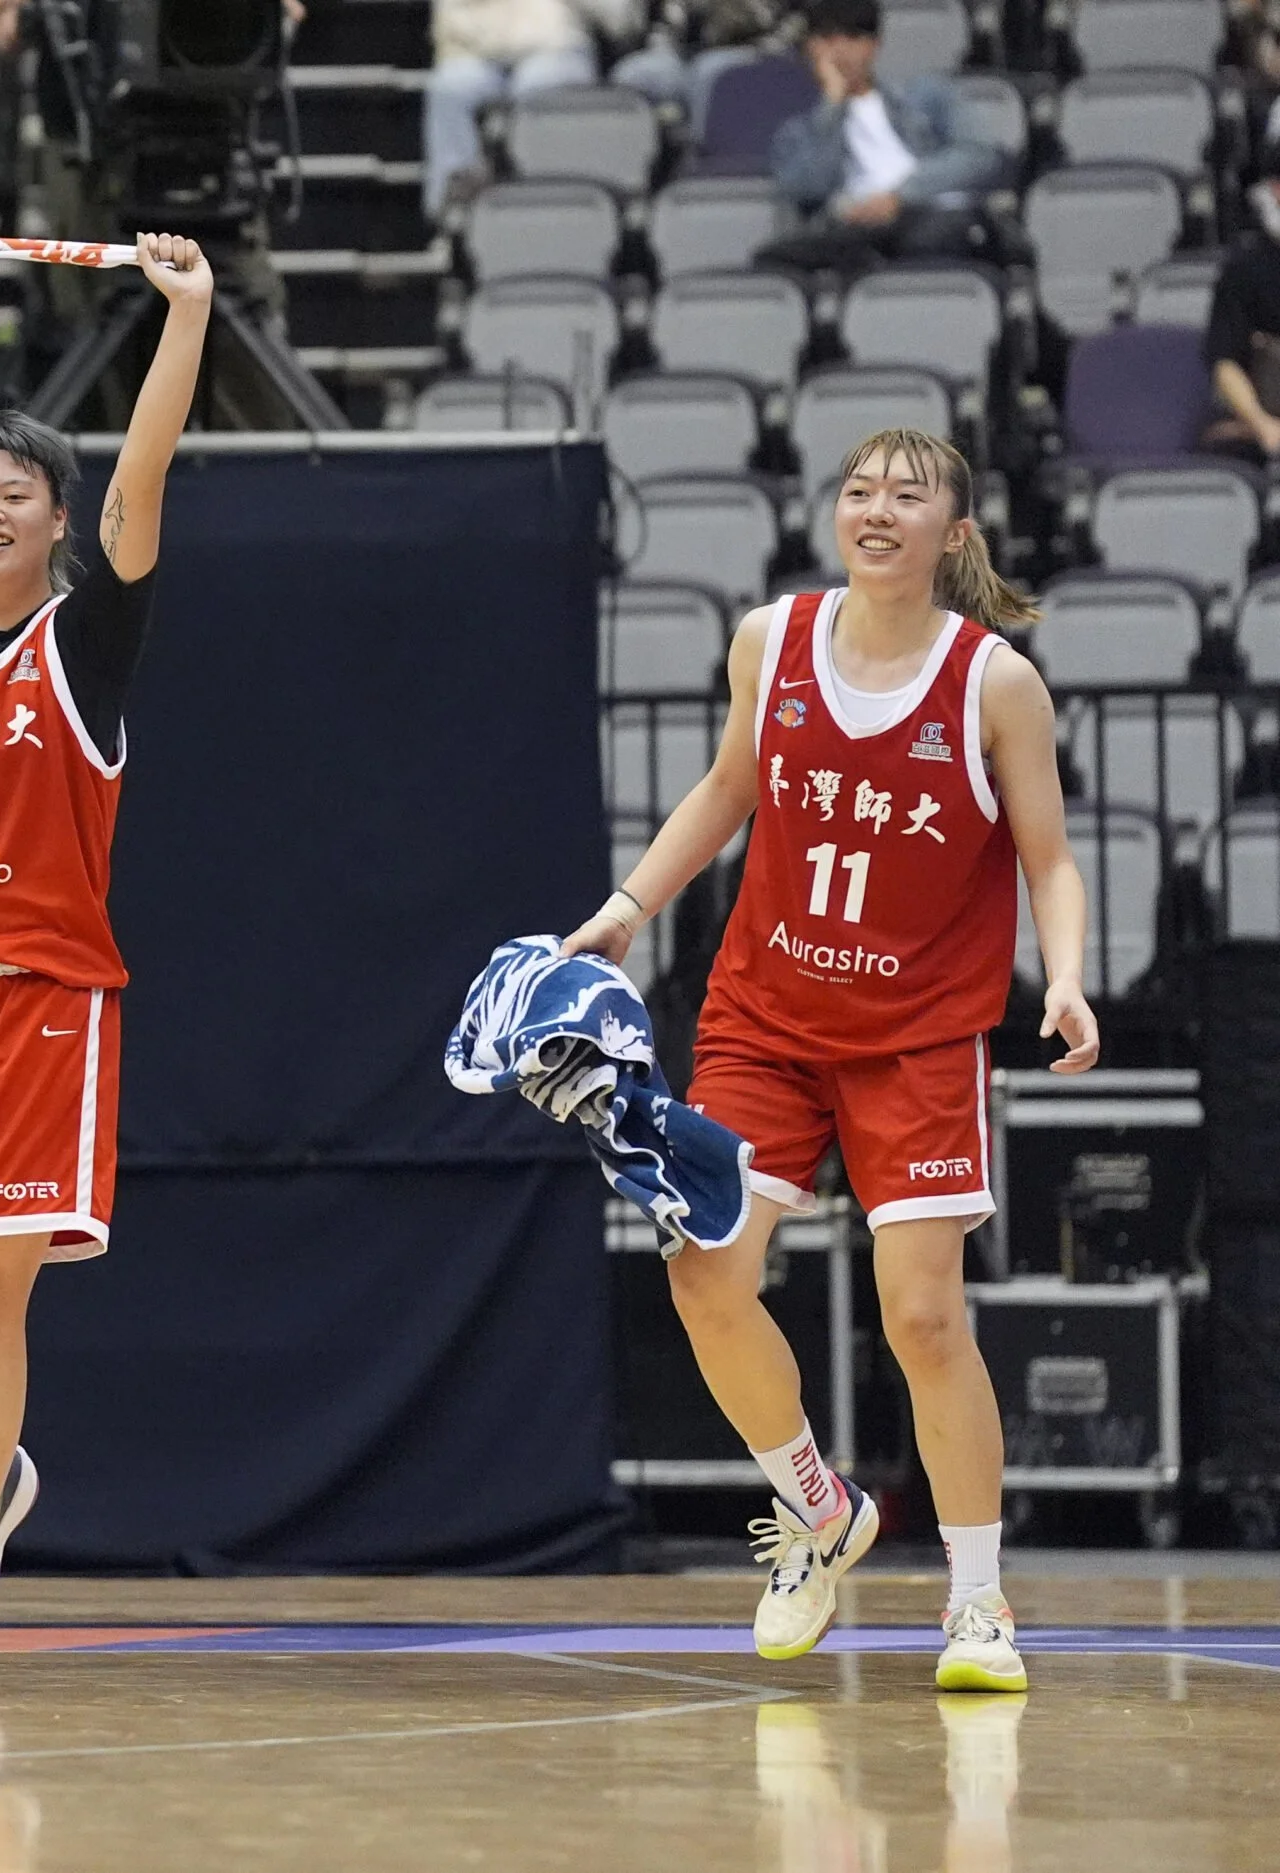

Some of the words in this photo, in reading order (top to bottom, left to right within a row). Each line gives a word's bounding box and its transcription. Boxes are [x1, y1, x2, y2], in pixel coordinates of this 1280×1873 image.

[768, 753, 947, 845] 臺灣師大
[805, 842, 871, 924] 11
[767, 920, 900, 978] Aurastro
[796, 967, 825, 981] CLOTHING
[828, 976, 854, 984] SELECT
[908, 1157, 973, 1181] FOOTER
[791, 1438, 829, 1507] NTNU
